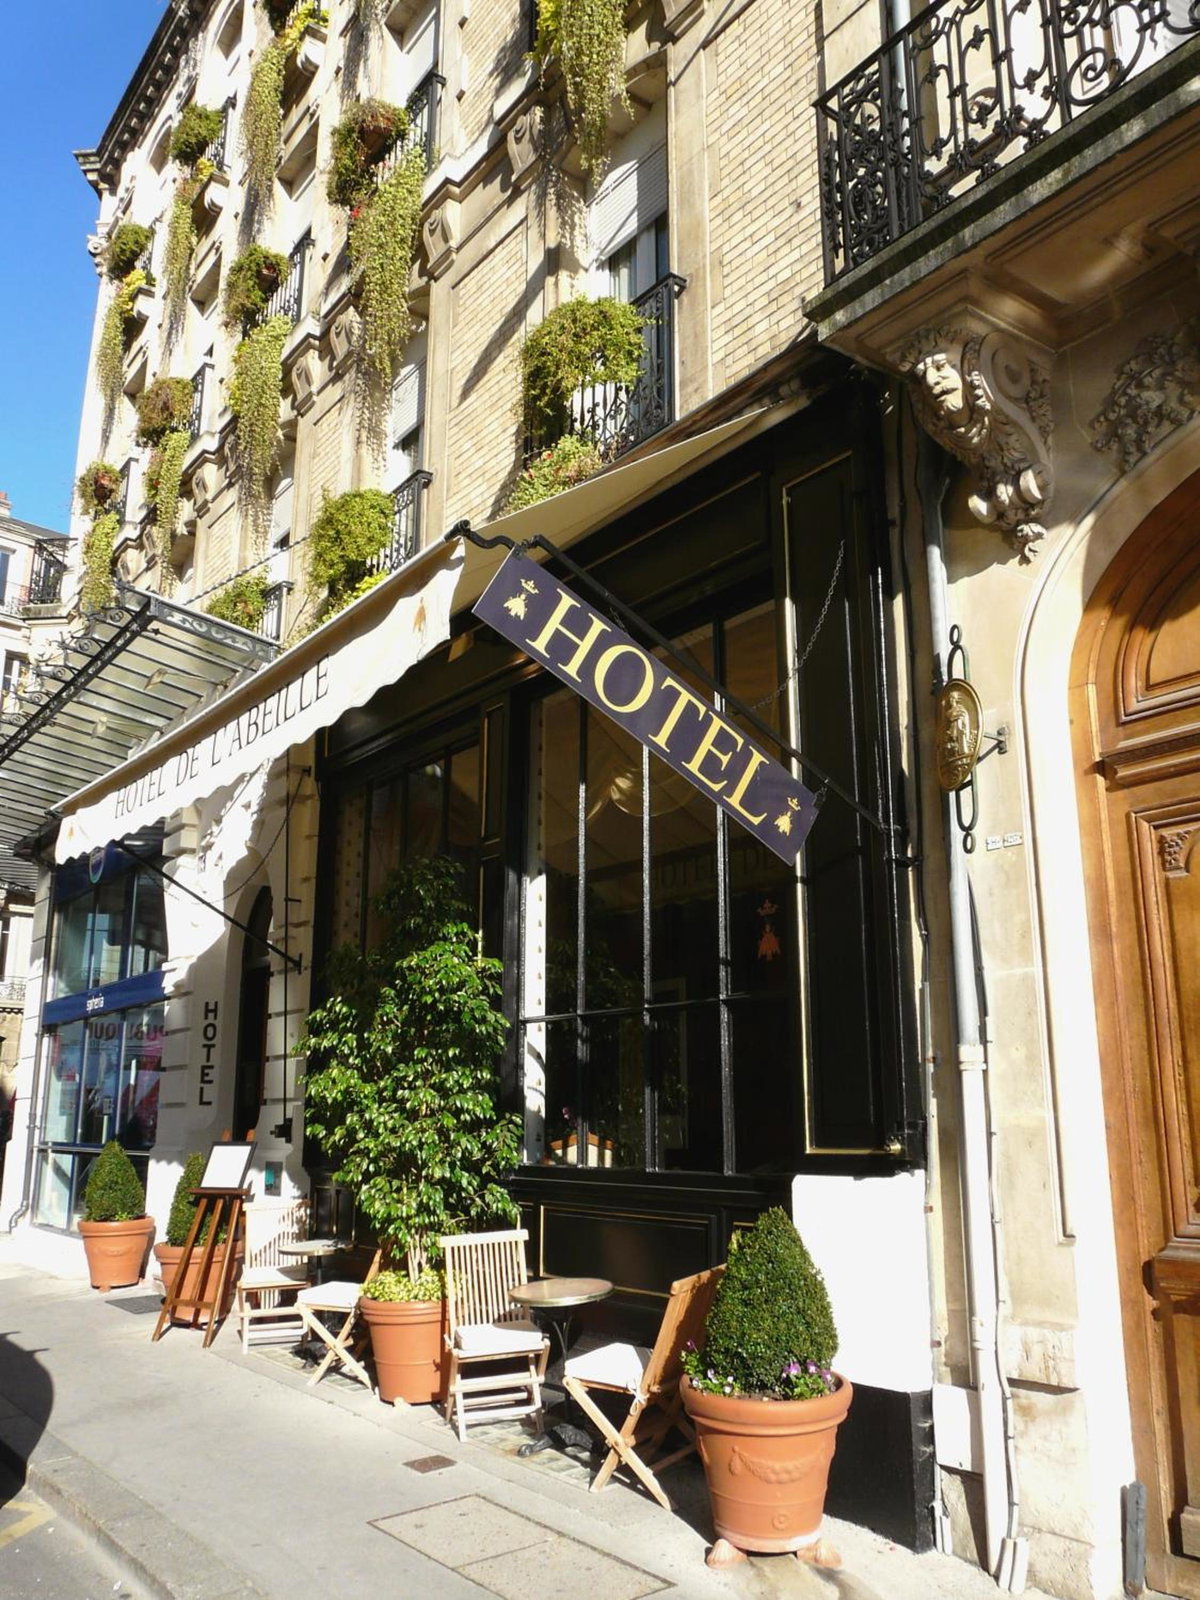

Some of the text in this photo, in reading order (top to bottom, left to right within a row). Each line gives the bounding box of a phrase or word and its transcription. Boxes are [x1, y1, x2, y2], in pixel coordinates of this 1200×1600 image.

[115, 654, 330, 819] HOTEL DE L'ABEILLE
[525, 588, 769, 825] HOTEL
[199, 1001, 218, 1106] HOTEL
